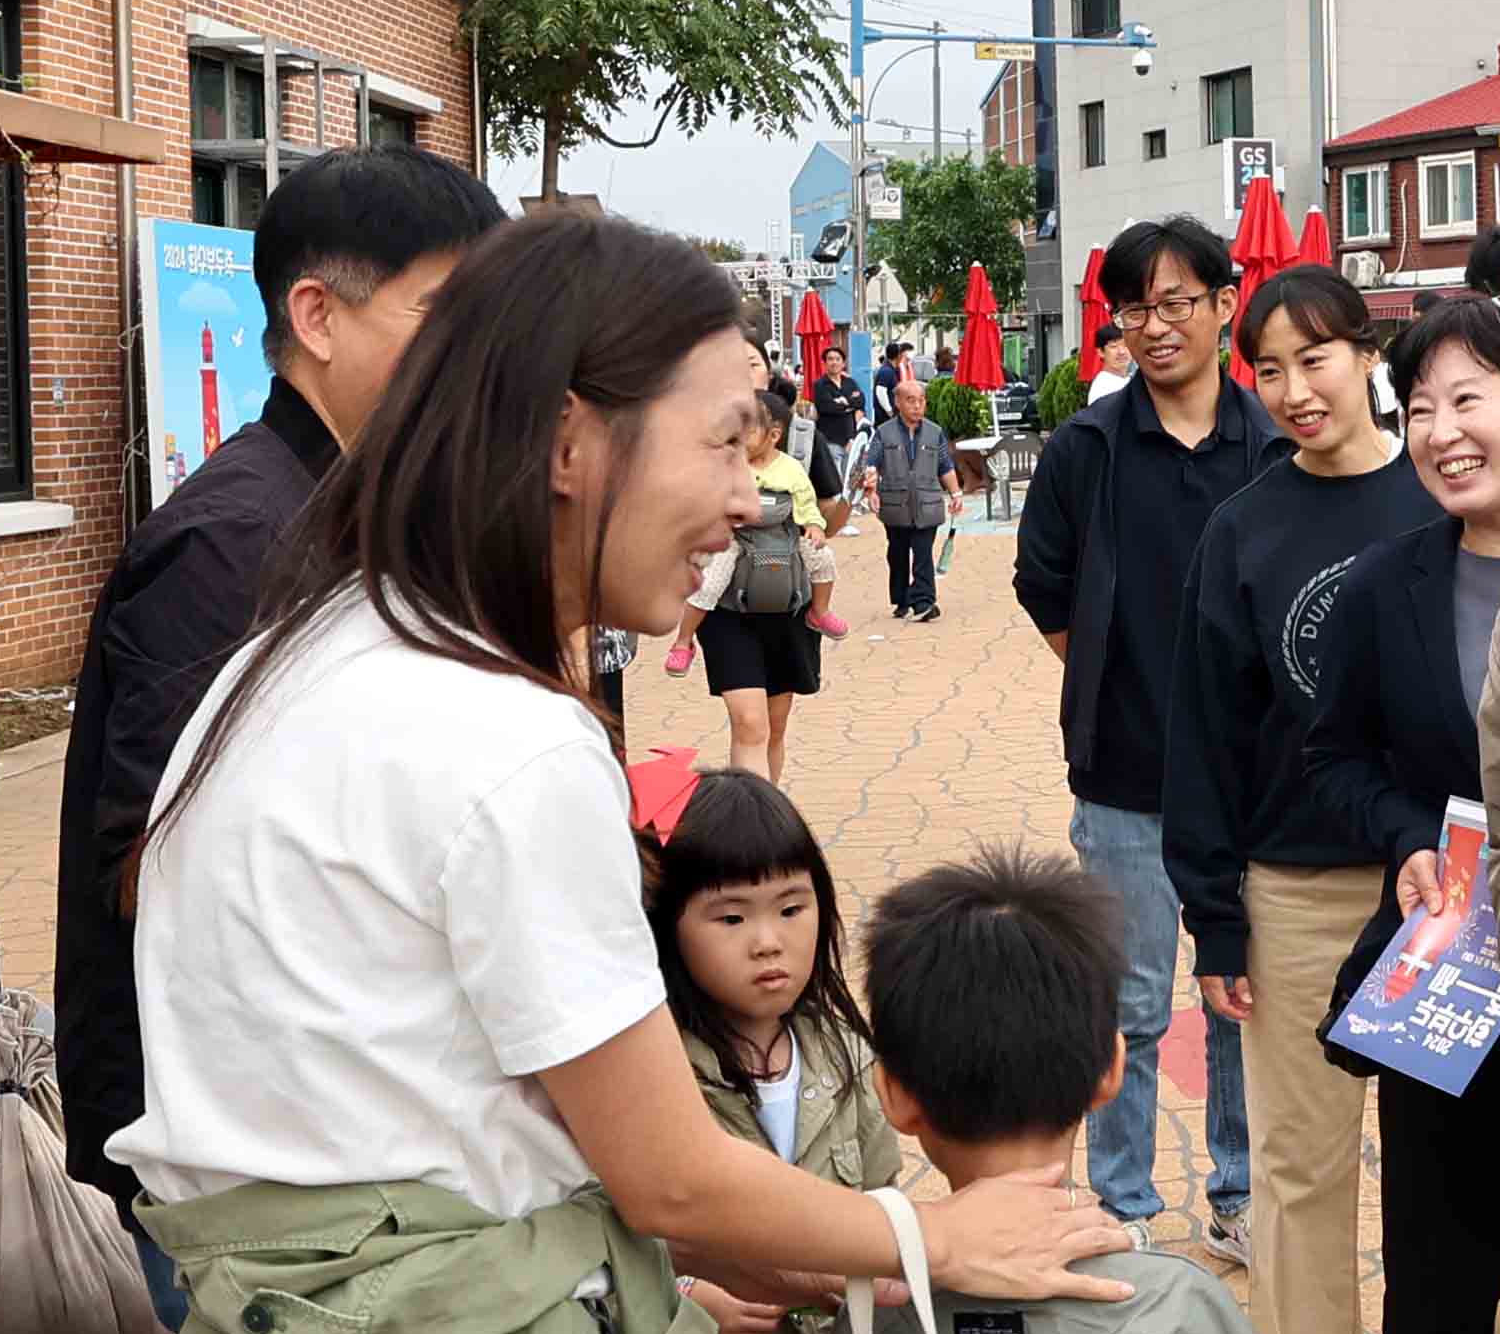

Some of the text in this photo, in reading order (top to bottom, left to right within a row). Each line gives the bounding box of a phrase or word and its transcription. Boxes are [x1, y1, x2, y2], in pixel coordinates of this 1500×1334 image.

[1240, 147, 1266, 165] GS
[1409, 995, 1496, 1049] 화수부두
[1421, 1032, 1455, 1057] 2024
